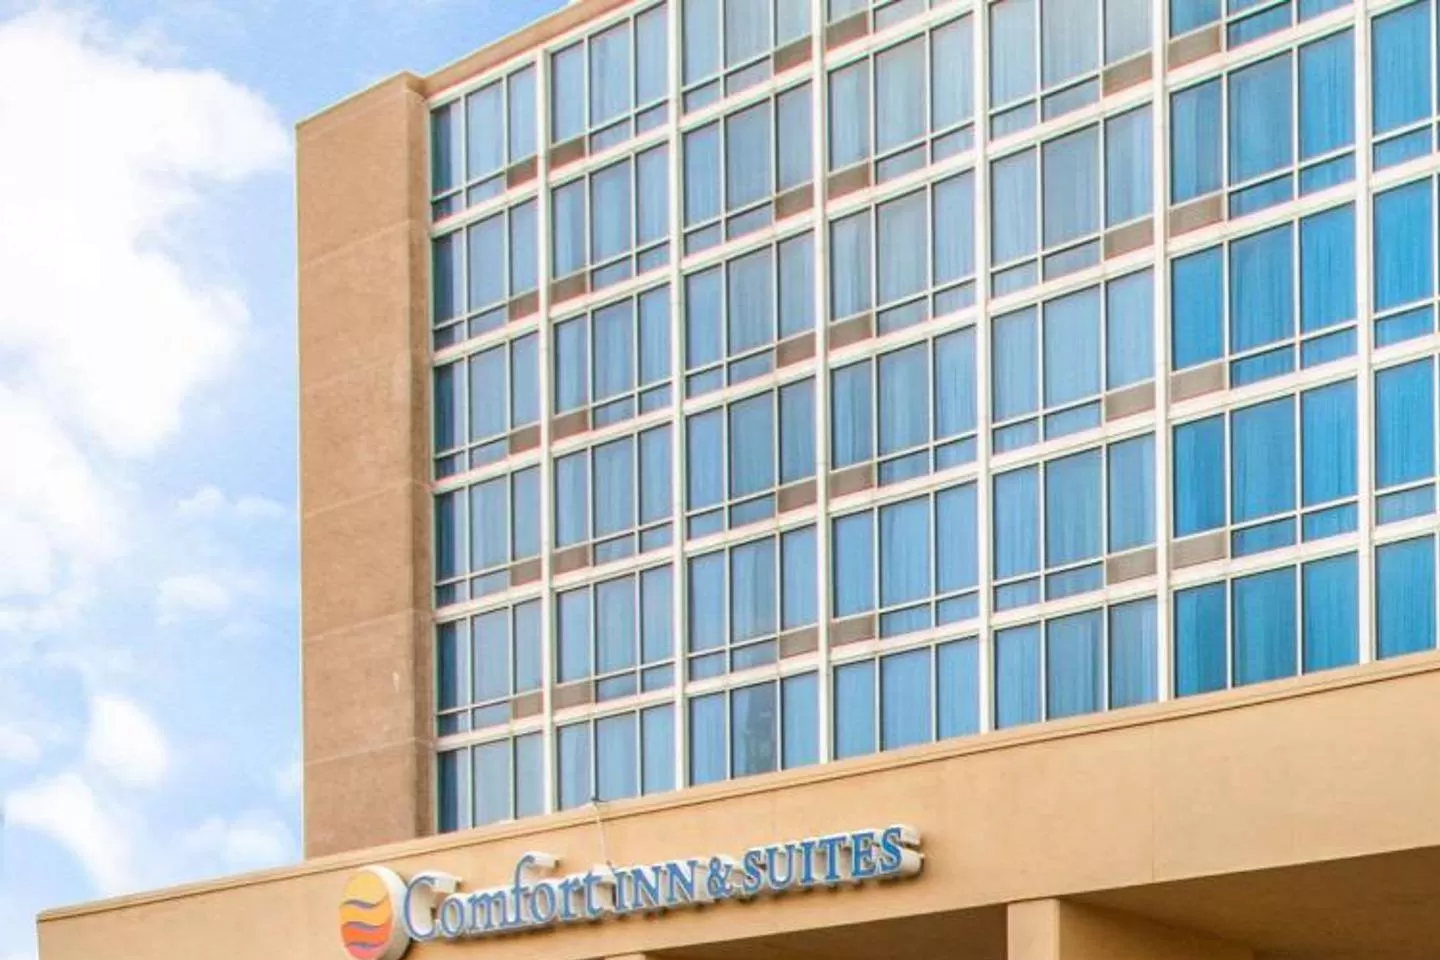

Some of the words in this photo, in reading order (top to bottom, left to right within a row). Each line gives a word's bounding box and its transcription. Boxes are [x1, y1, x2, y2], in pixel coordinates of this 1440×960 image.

[403, 854, 603, 939] Comfort
[613, 859, 699, 913] INN
[706, 855, 733, 898] &
[742, 826, 902, 893] SUITES
